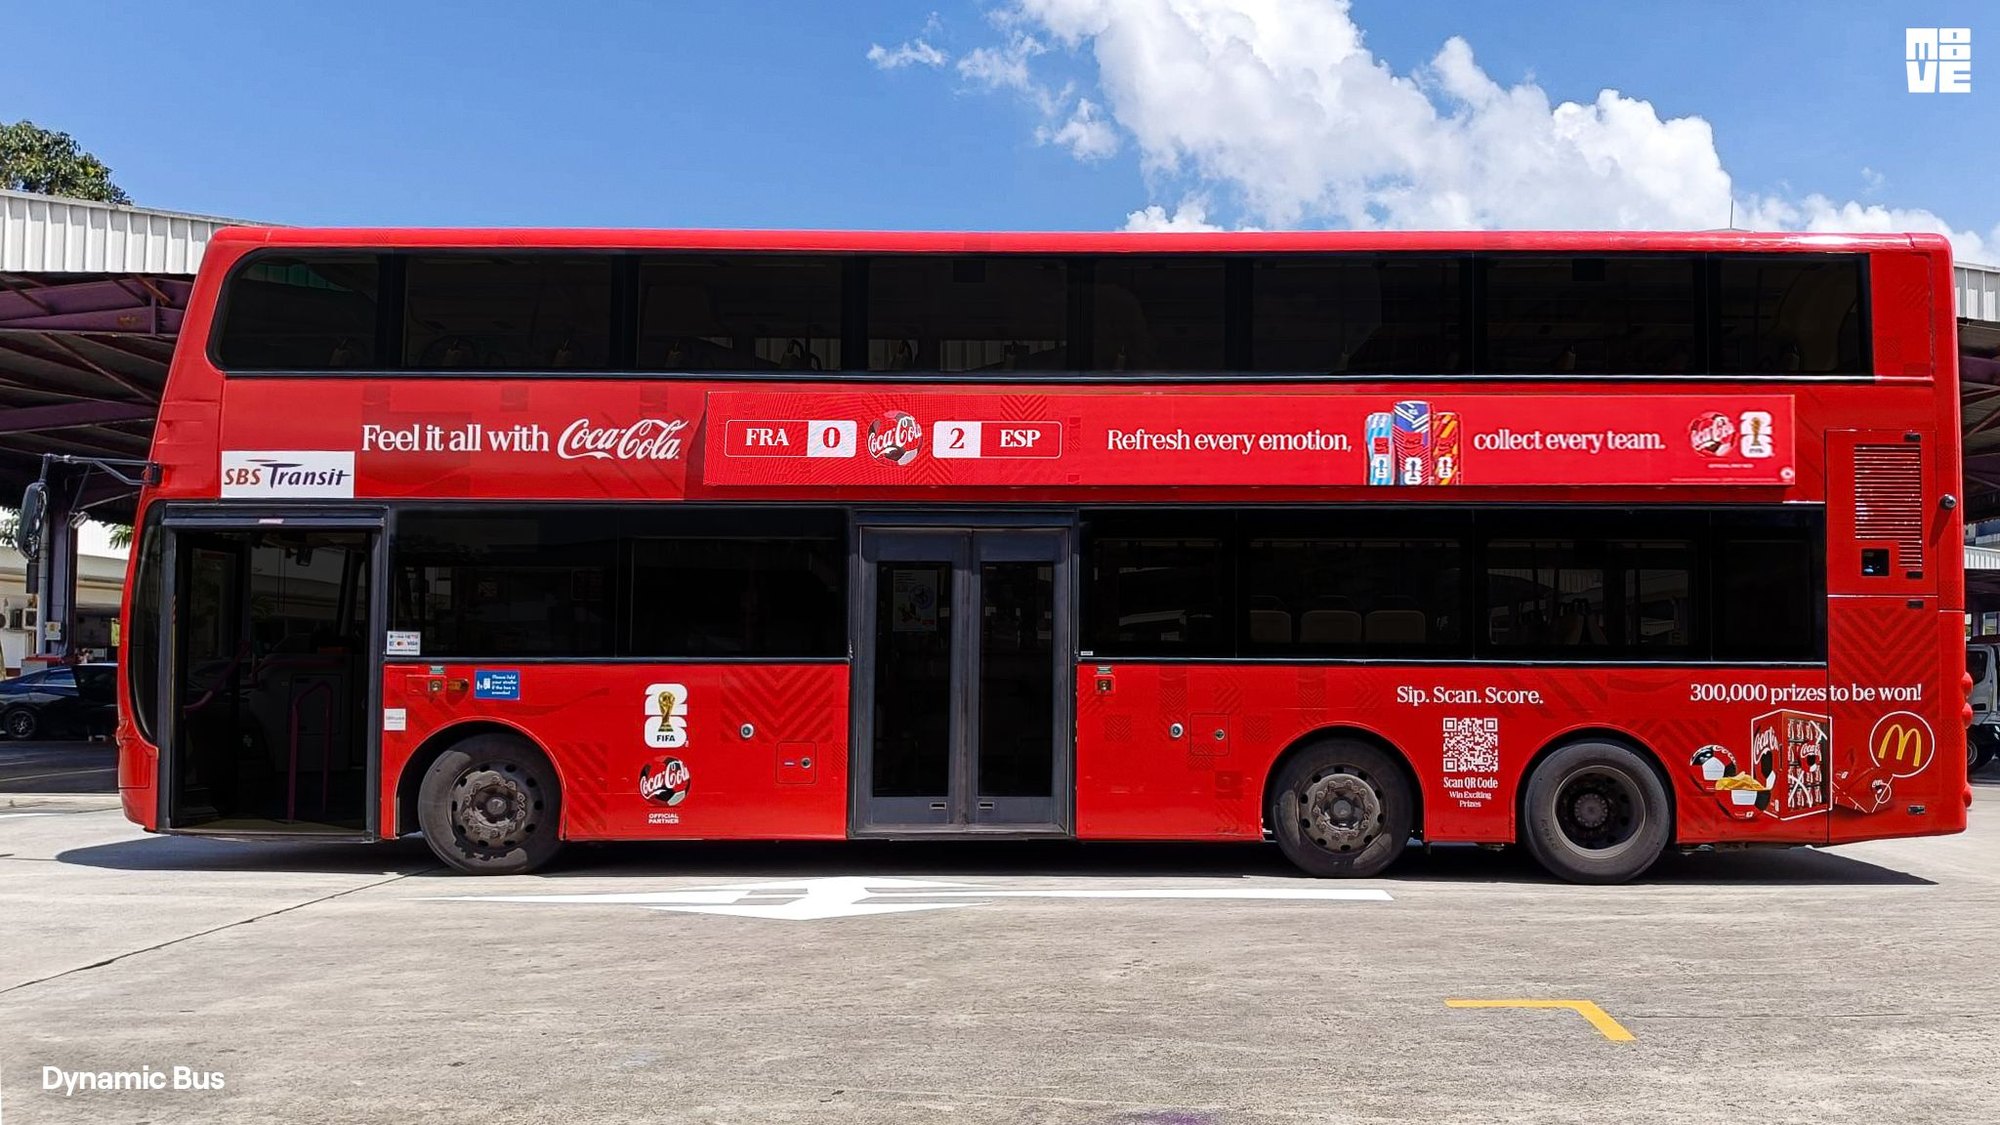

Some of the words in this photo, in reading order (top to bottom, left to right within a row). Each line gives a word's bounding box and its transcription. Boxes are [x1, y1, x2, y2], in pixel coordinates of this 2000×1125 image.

[362, 424, 420, 451] Feel
[426, 424, 444, 451] it
[449, 424, 482, 451] all
[487, 424, 549, 451] with
[557, 418, 689, 460] Coca-Cola
[745, 428, 790, 446] FRA
[822, 427, 840, 448] 0
[950, 428, 965, 449] 2
[1000, 429, 1041, 448] ESP
[1107, 429, 1191, 450] Refresh
[1194, 434, 1255, 454] every
[1258, 430, 1352, 453] emotion,
[1474, 429, 1542, 450] collect
[1549, 434, 1602, 454] every
[1606, 432, 1666, 450] team.
[224, 468, 262, 485] SBS
[260, 463, 352, 488] Transit
[1396, 686, 1429, 706] Sip.
[1433, 687, 1482, 704] Scan.
[1485, 687, 1544, 704] Score.
[1690, 684, 1768, 703] 300,000
[1770, 684, 1827, 704] prizes
[1830, 686, 1849, 701] to
[1852, 684, 1875, 701] be
[1879, 684, 1922, 701] won!
[656, 734, 676, 742] FIFA
[1443, 776, 1463, 788] Scan
[1464, 777, 1477, 789] QR
[1477, 777, 1498, 788] Code
[1449, 791, 1463, 799] Win
[1464, 791, 1492, 800] Exciting
[1459, 800, 1482, 808] Prizes
